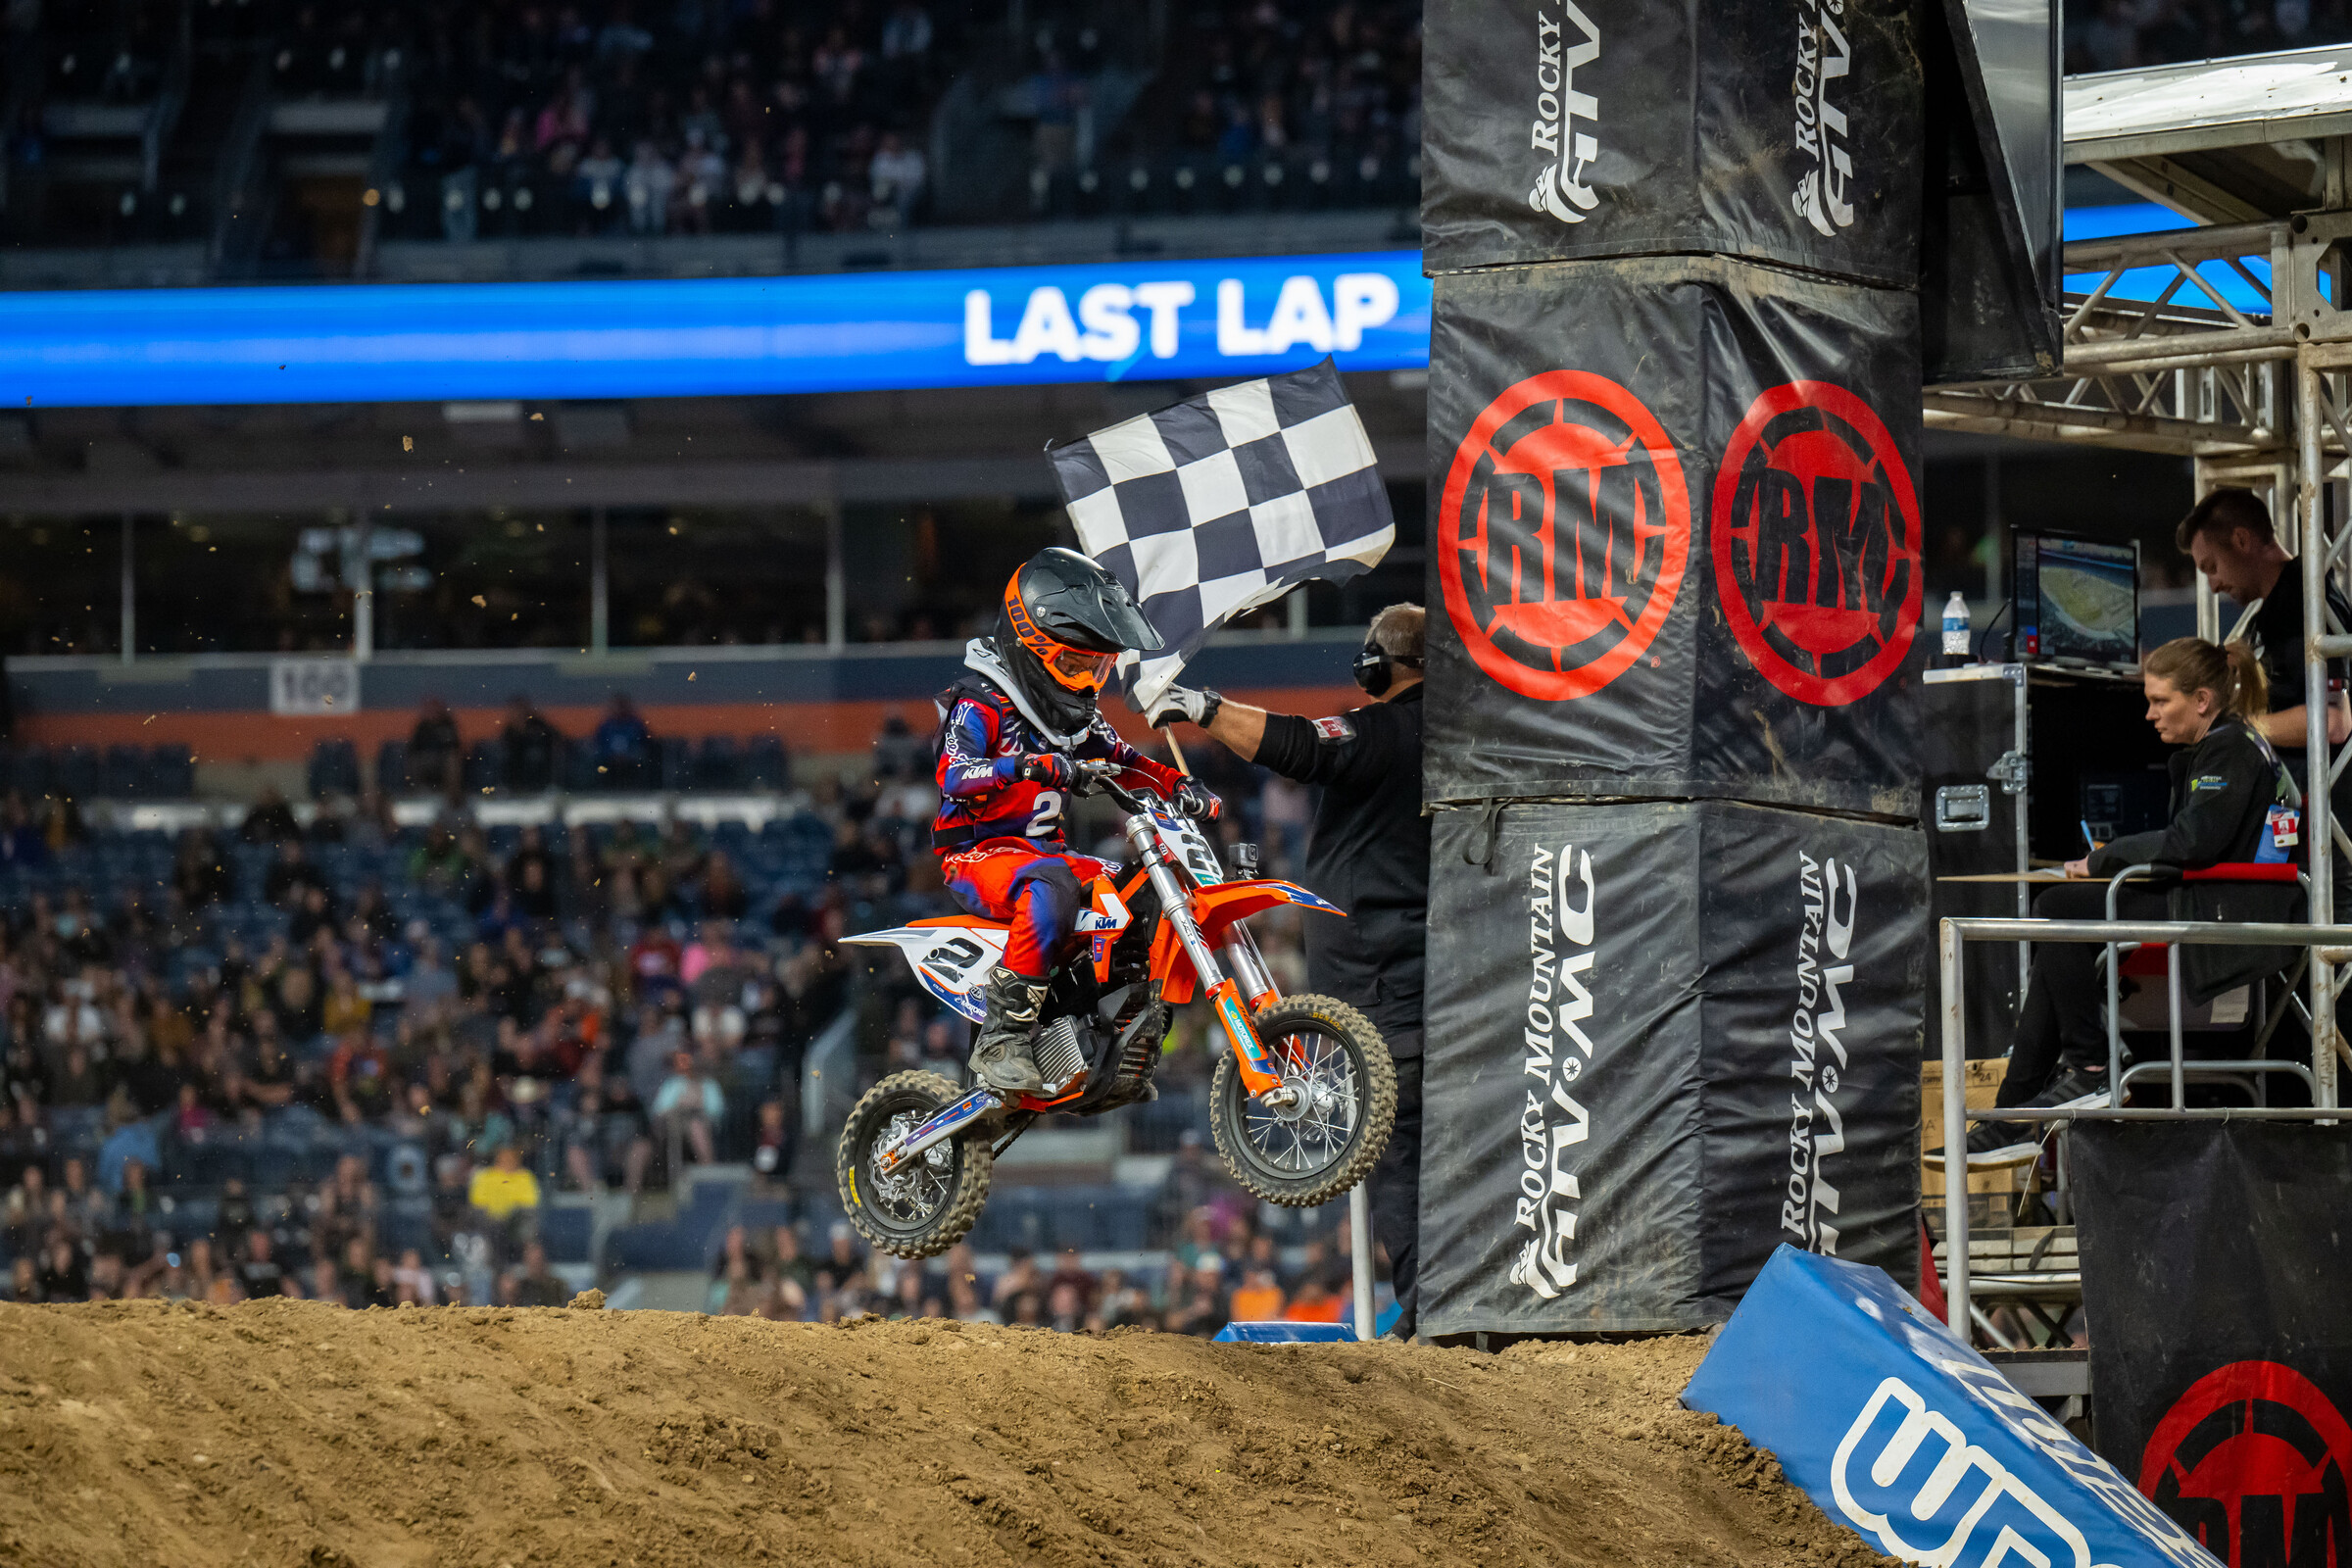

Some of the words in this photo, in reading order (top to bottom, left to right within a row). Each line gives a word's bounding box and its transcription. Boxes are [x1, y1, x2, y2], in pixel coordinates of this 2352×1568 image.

[1532, 11, 1561, 156] ROCKY
[1794, 12, 1818, 162] ROCKY
[964, 280, 1196, 366] LAST
[1216, 272, 1400, 357] LAP
[1007, 595, 1055, 656] 100%
[961, 763, 994, 780] KTM
[1025, 791, 1062, 838] 2
[1095, 916, 1117, 930] KTM
[1525, 842, 1554, 1086] MOUNTAIN
[1791, 851, 1823, 1091] MOUNTAIN
[1234, 1018, 1255, 1051] MOTOREX
[1514, 1090, 1547, 1232] ROCKY
[1781, 1093, 1813, 1240] ROCKY
